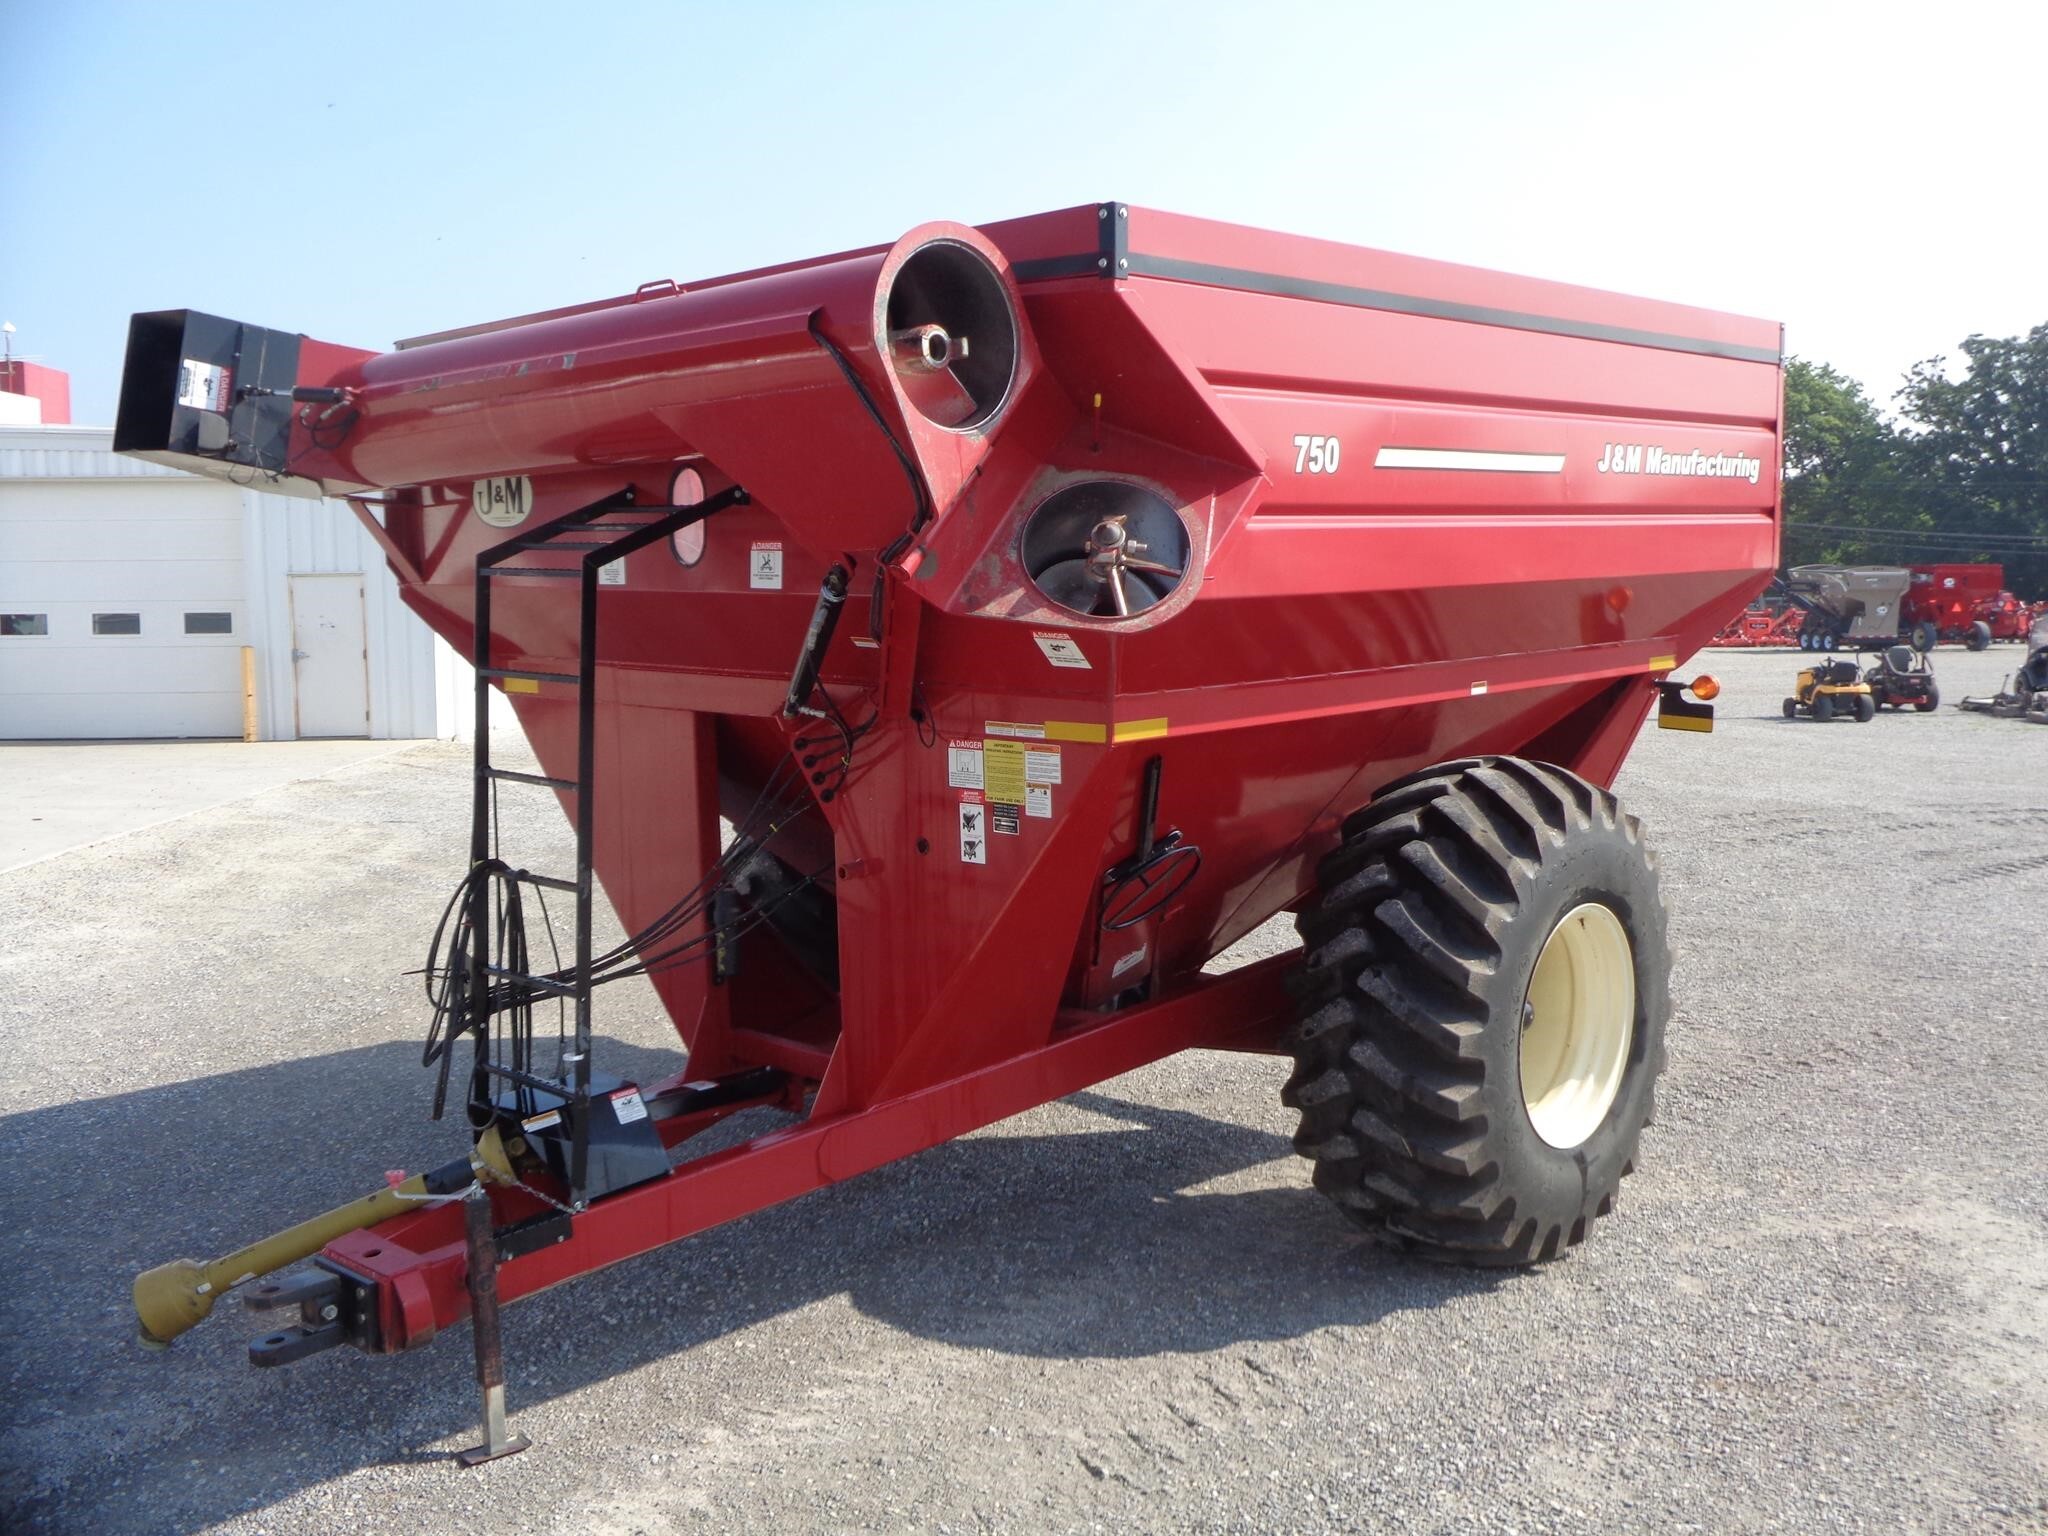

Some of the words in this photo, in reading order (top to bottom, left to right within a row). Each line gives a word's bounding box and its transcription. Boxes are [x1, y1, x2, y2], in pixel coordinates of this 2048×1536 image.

[217, 377, 230, 412] DANGER
[1293, 434, 1340, 475] 750
[1597, 443, 1642, 473] J&M
[1645, 445, 1760, 484] Manufacturing
[477, 476, 525, 515] J&M
[956, 740, 983, 749] DANGER
